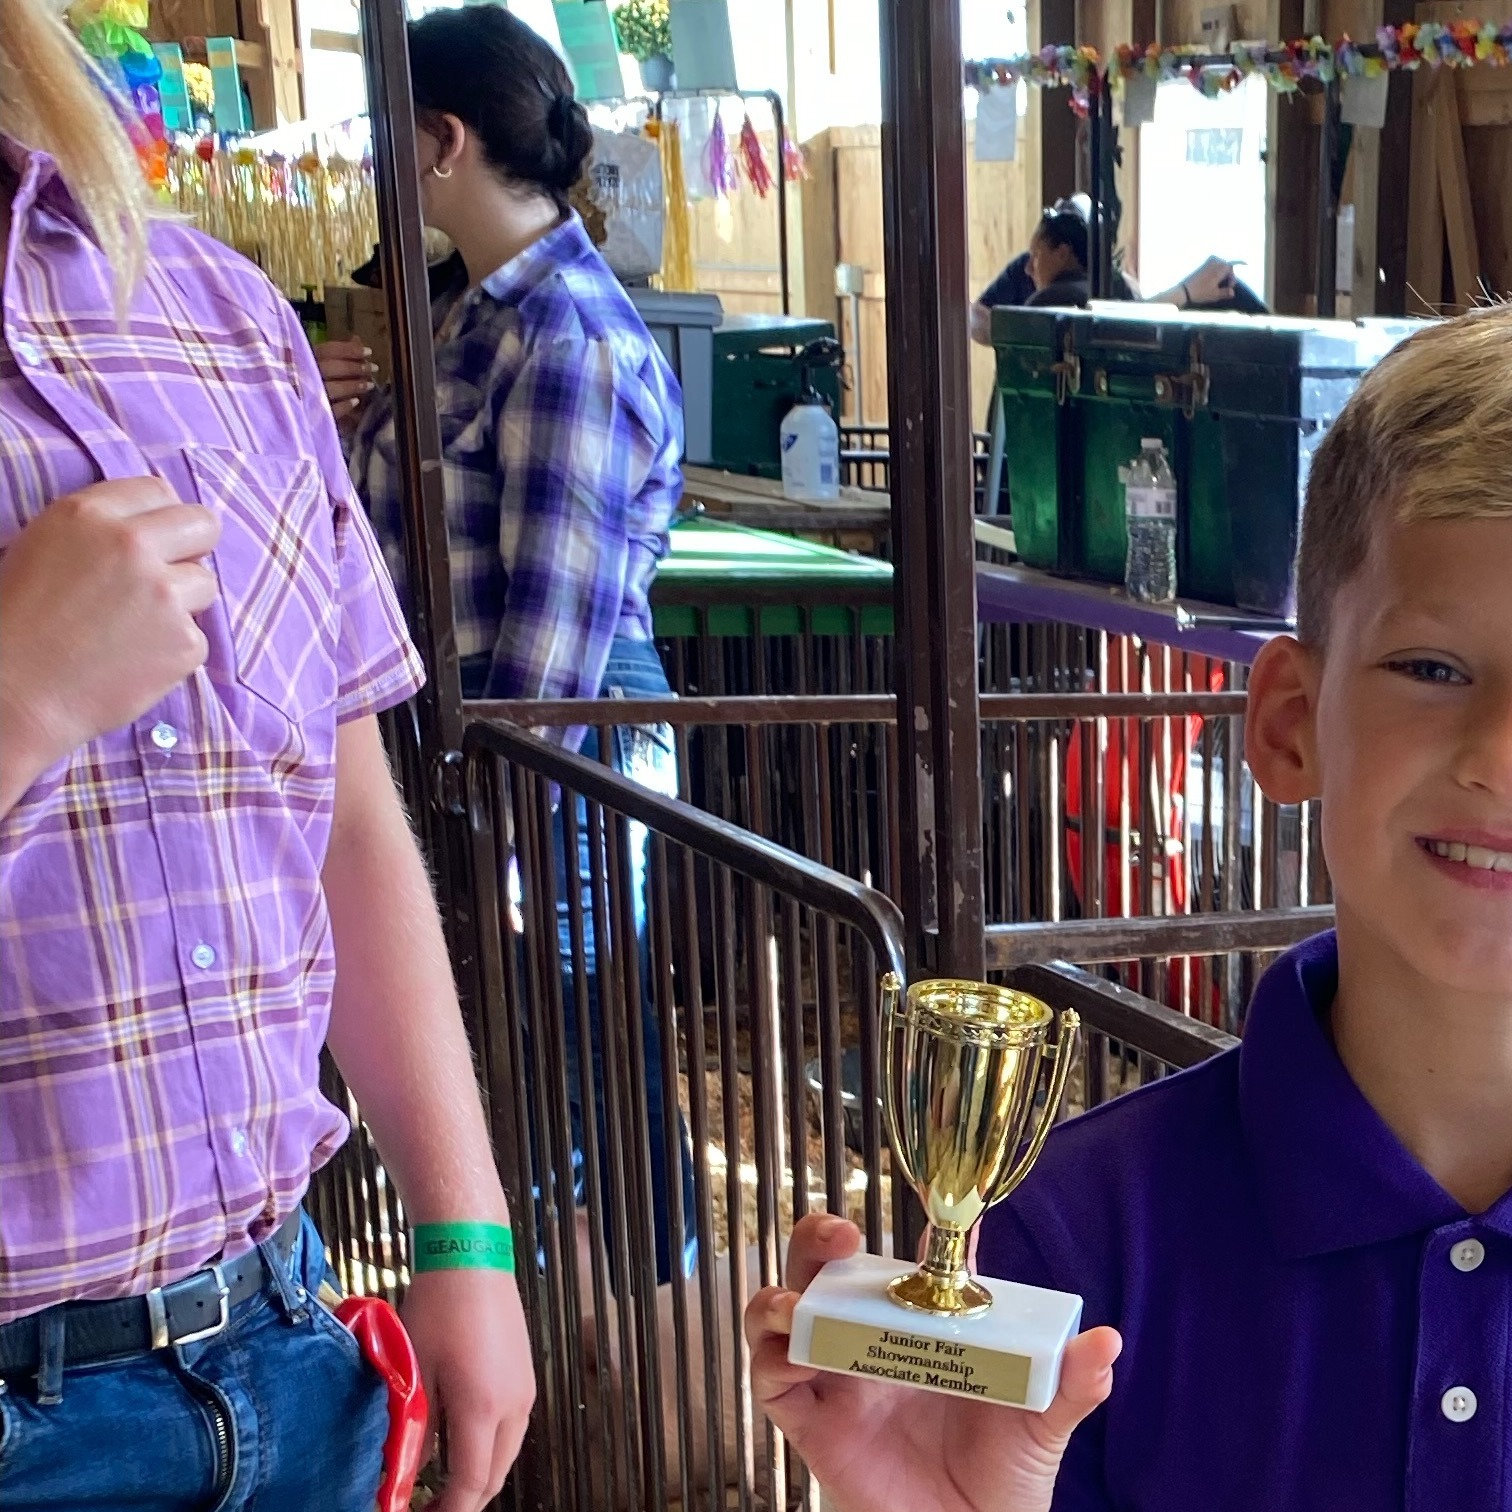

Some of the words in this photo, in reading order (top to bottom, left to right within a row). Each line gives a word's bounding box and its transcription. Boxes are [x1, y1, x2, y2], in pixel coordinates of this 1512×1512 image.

[426, 1239, 494, 1256] GEAUGA
[879, 1331, 931, 1351] Junior
[935, 1340, 967, 1357] Fair
[867, 1345, 974, 1378] Showmanship
[849, 1360, 921, 1383] Associate
[924, 1371, 988, 1395] Member
